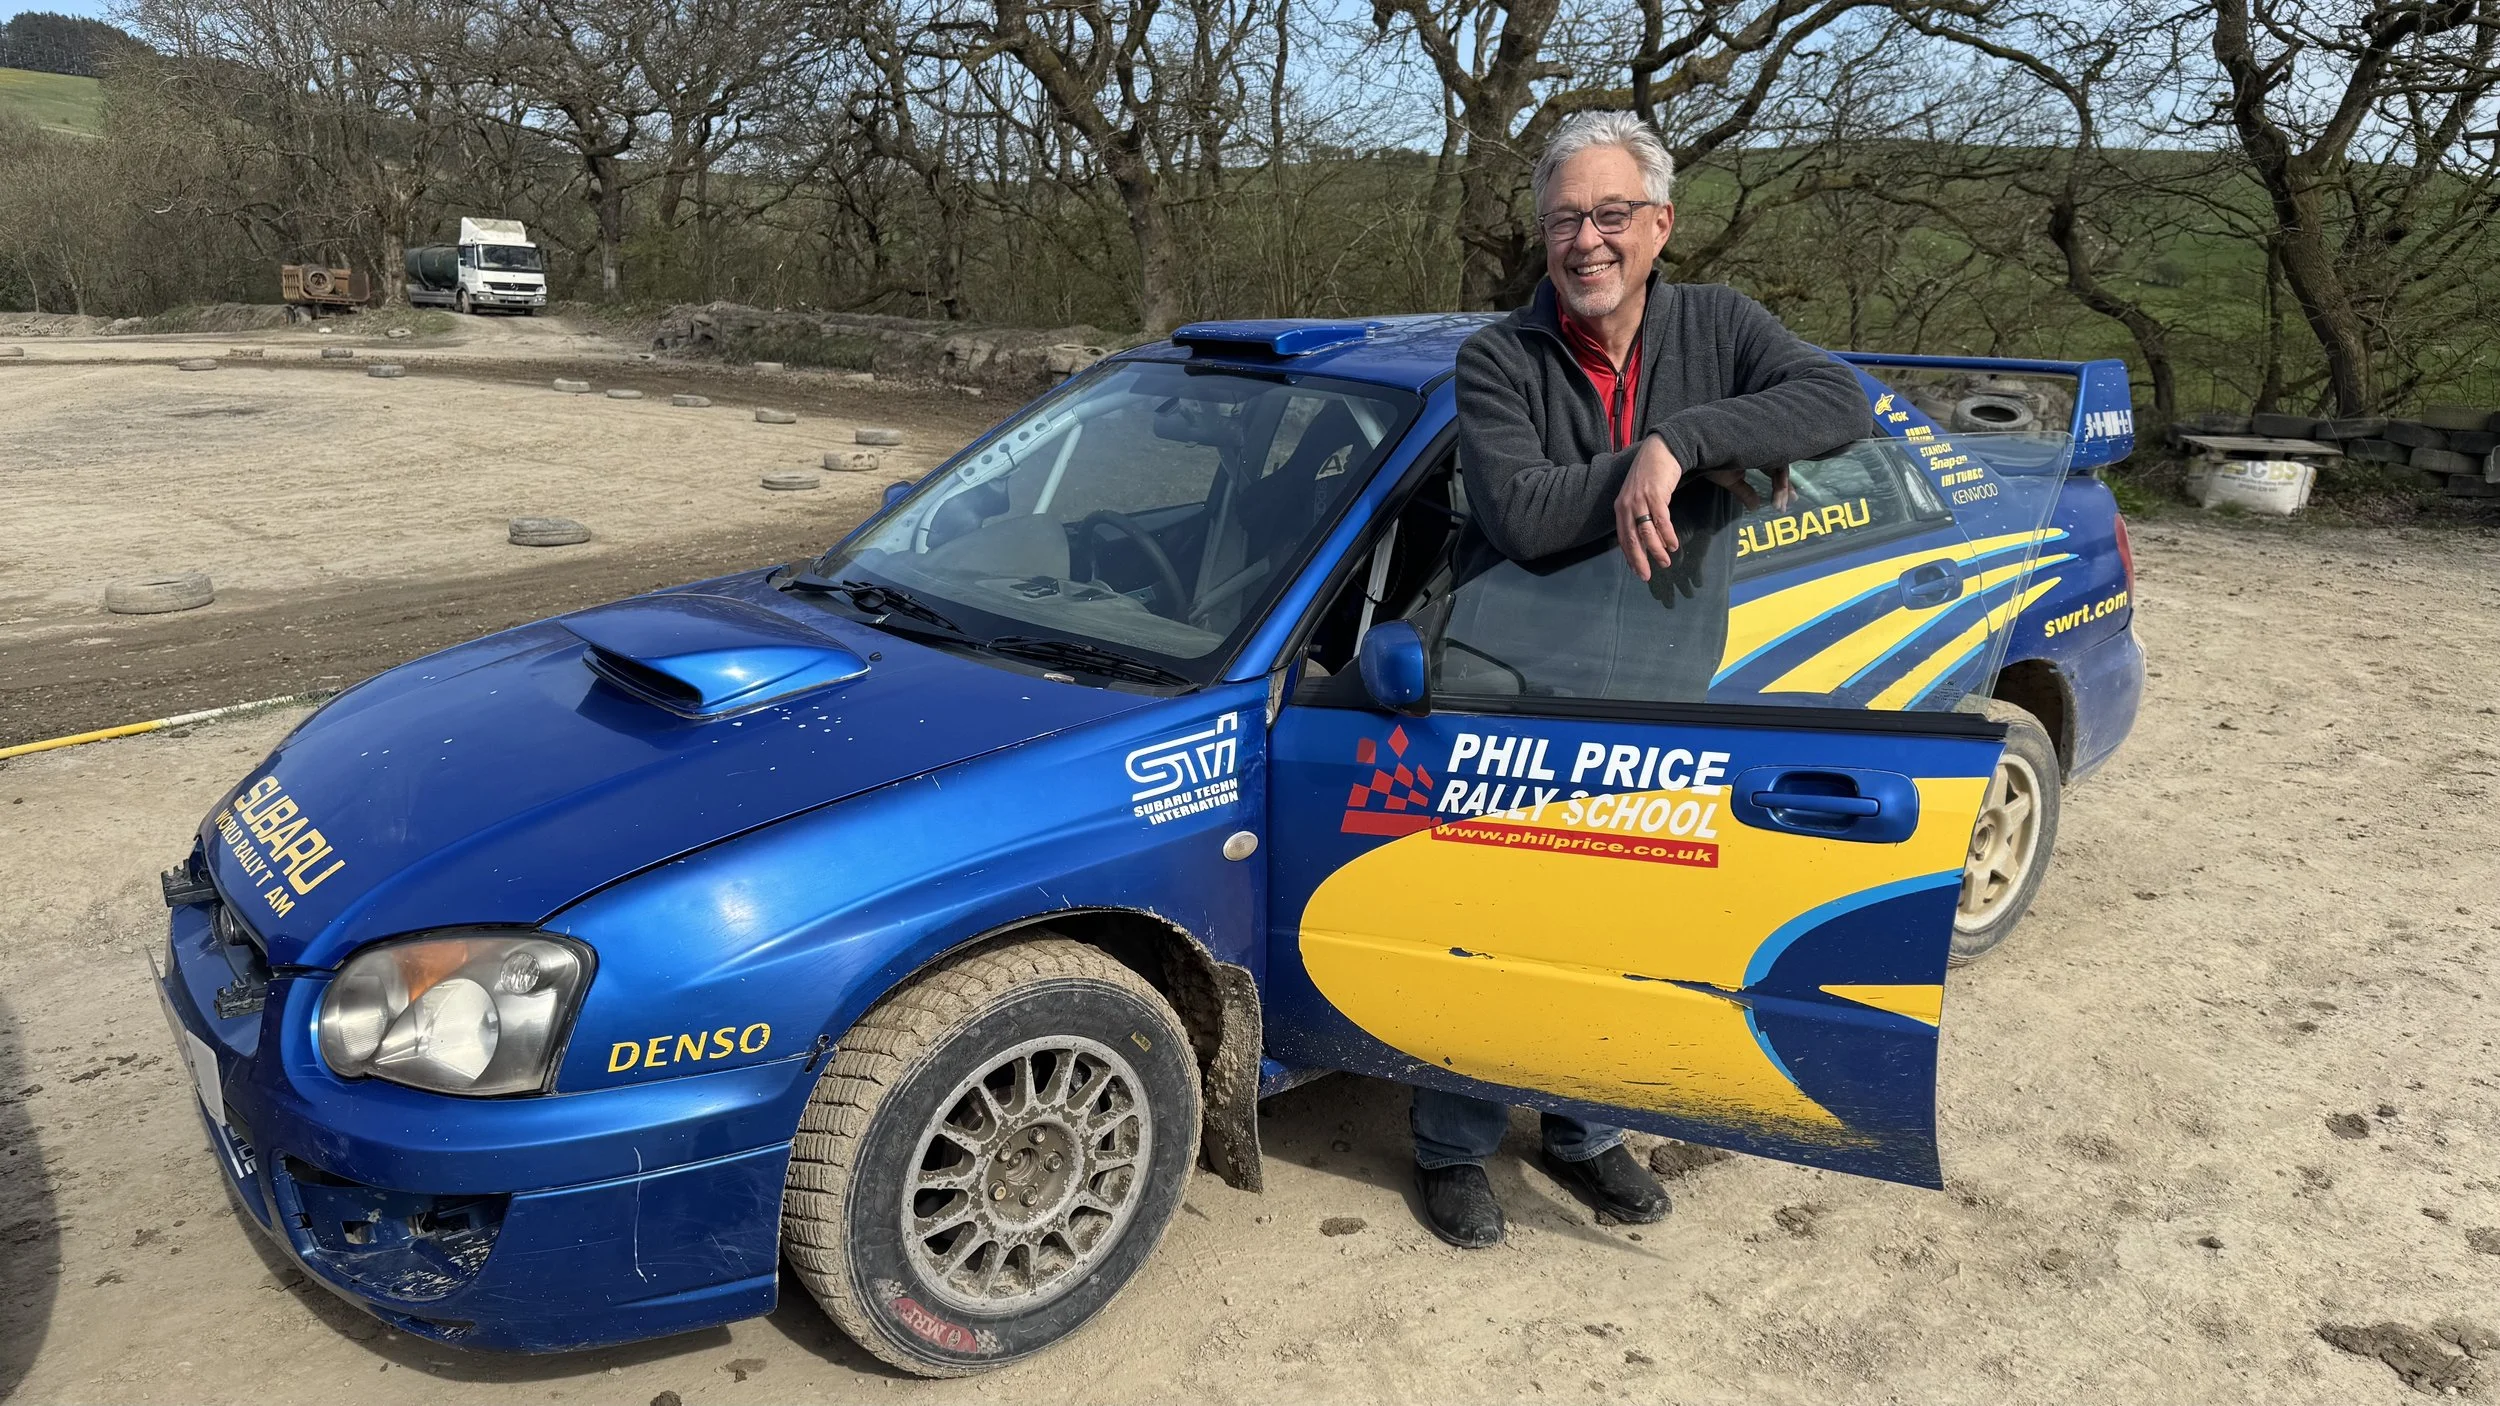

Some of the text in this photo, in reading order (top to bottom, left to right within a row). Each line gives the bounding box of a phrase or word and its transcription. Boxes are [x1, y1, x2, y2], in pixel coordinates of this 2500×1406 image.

[1888, 411, 1909, 423] NGK
[1920, 443, 1953, 458] STANDOX
[1930, 455, 1968, 471] Snap-on
[1952, 483, 1998, 505] KENWOOD
[1737, 498, 1870, 557] SUBARU
[2045, 591, 2128, 638] swrt.com
[1447, 733, 1731, 796] PHIL PRICE
[1133, 778, 1238, 818] SUBARU TECHN
[1149, 790, 1239, 826] INTERNATION
[1437, 779, 1717, 838] RALLY SCHOOL
[215, 808, 244, 845] WORLD
[233, 839, 267, 877] RALLY
[234, 776, 346, 895] SUBARU
[1435, 825, 1713, 862] www.philprice.co.uk
[608, 1022, 771, 1073] DENSO
